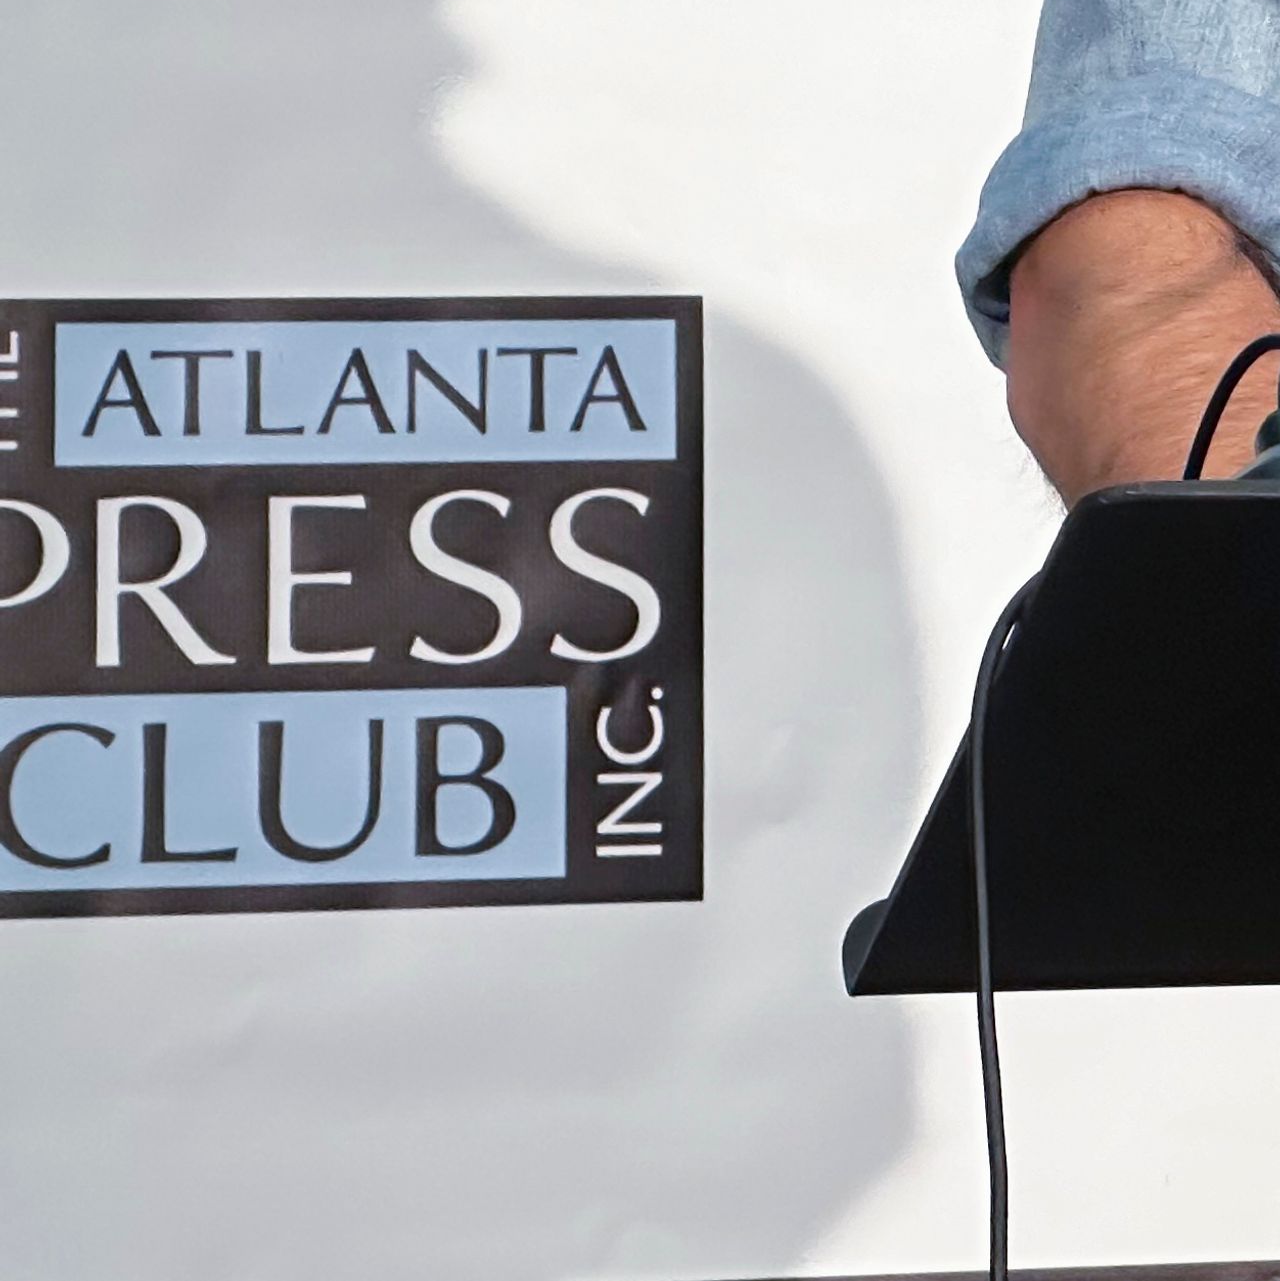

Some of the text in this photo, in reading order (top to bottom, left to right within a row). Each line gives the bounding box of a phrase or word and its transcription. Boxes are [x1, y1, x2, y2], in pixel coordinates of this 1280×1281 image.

[82, 345, 648, 437] ATLANTA
[0, 716, 517, 870] CLUB
[596, 686, 663, 857] INC.
